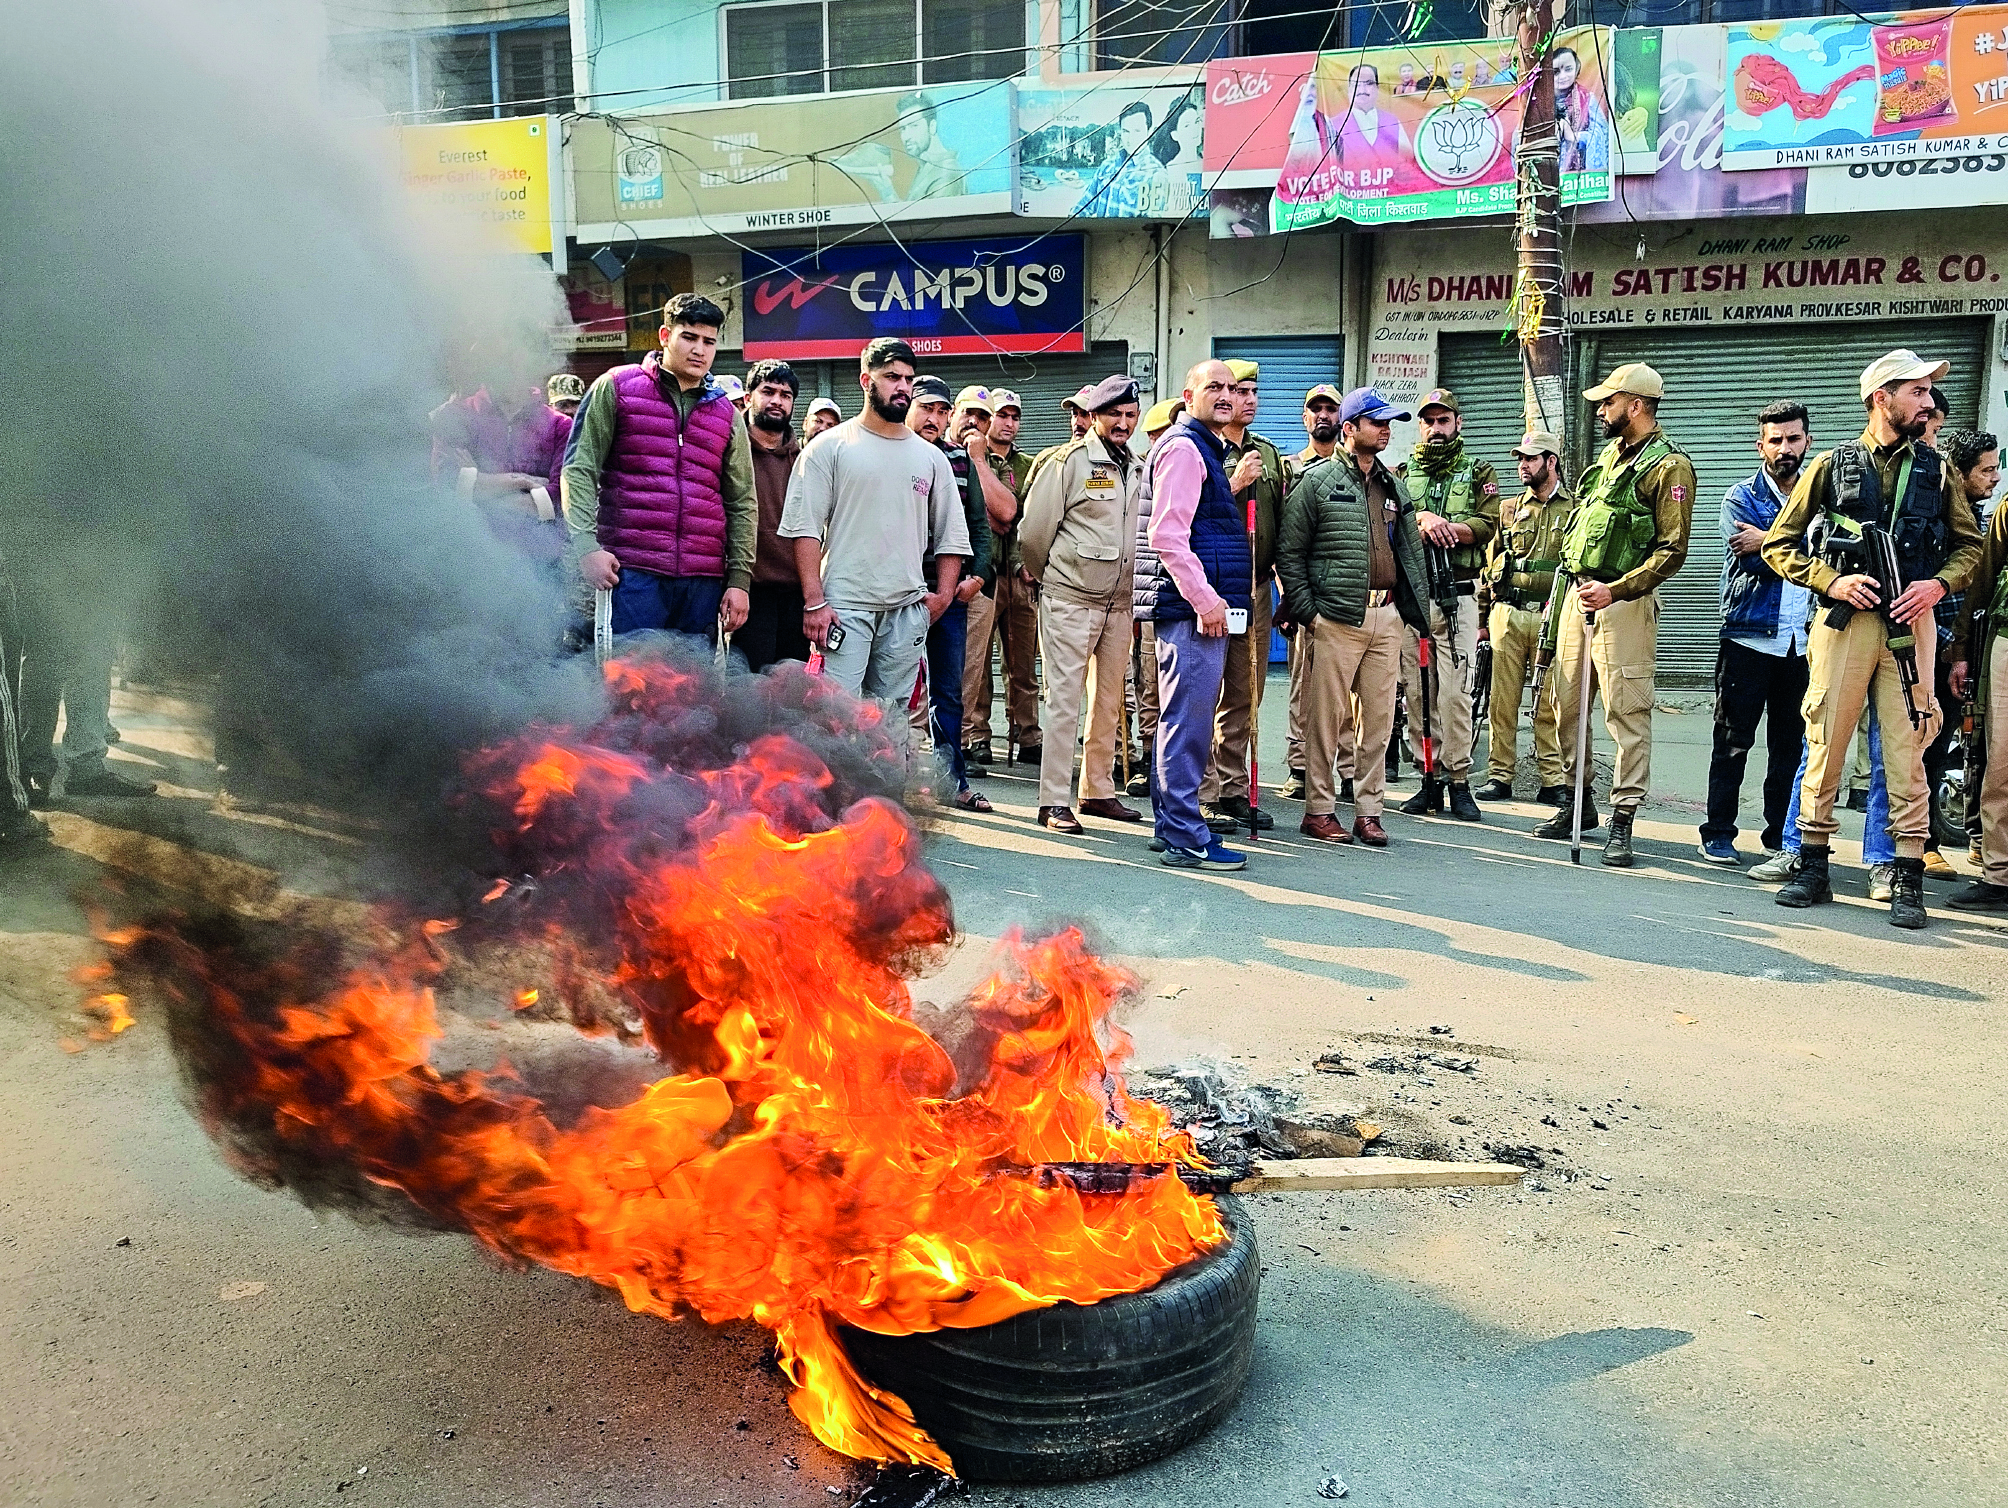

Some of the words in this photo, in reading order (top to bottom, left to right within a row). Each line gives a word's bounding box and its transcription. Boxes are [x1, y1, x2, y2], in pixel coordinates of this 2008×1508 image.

[1212, 68, 1272, 106] Catch
[438, 149, 488, 164] Everest
[1776, 148, 1819, 165] DHANI
[1826, 146, 1854, 161] RAM
[1860, 142, 1917, 157] SATISH
[1925, 138, 1970, 153] KUMAR
[1977, 137, 1989, 149] &
[1286, 173, 1329, 195] VOTE
[1329, 165, 1355, 187] FOR
[1360, 167, 1394, 187] BJP
[494, 185, 527, 201] food
[622, 185, 660, 199] CHIEF
[1456, 189, 1484, 205] Ms.
[746, 212, 795, 228] WINTER
[798, 210, 832, 224] SHOE
[1698, 238, 1749, 256] DHANI
[1752, 236, 1793, 253] RAM
[1801, 234, 1851, 251] SHOP
[1427, 274, 1513, 302] DHANI
[1611, 264, 1747, 297] SATISH
[1762, 257, 1887, 288] KUMAR
[1896, 256, 1927, 284] &
[1938, 254, 2000, 283] CO.
[1385, 311, 1401, 322] GST
[1645, 308, 1656, 324] &
[1662, 306, 1713, 322] RETAIL
[1723, 305, 1794, 320] KARYANA
[1888, 299, 1963, 315] KISHTWARI
[911, 340, 942, 352] SHOES
